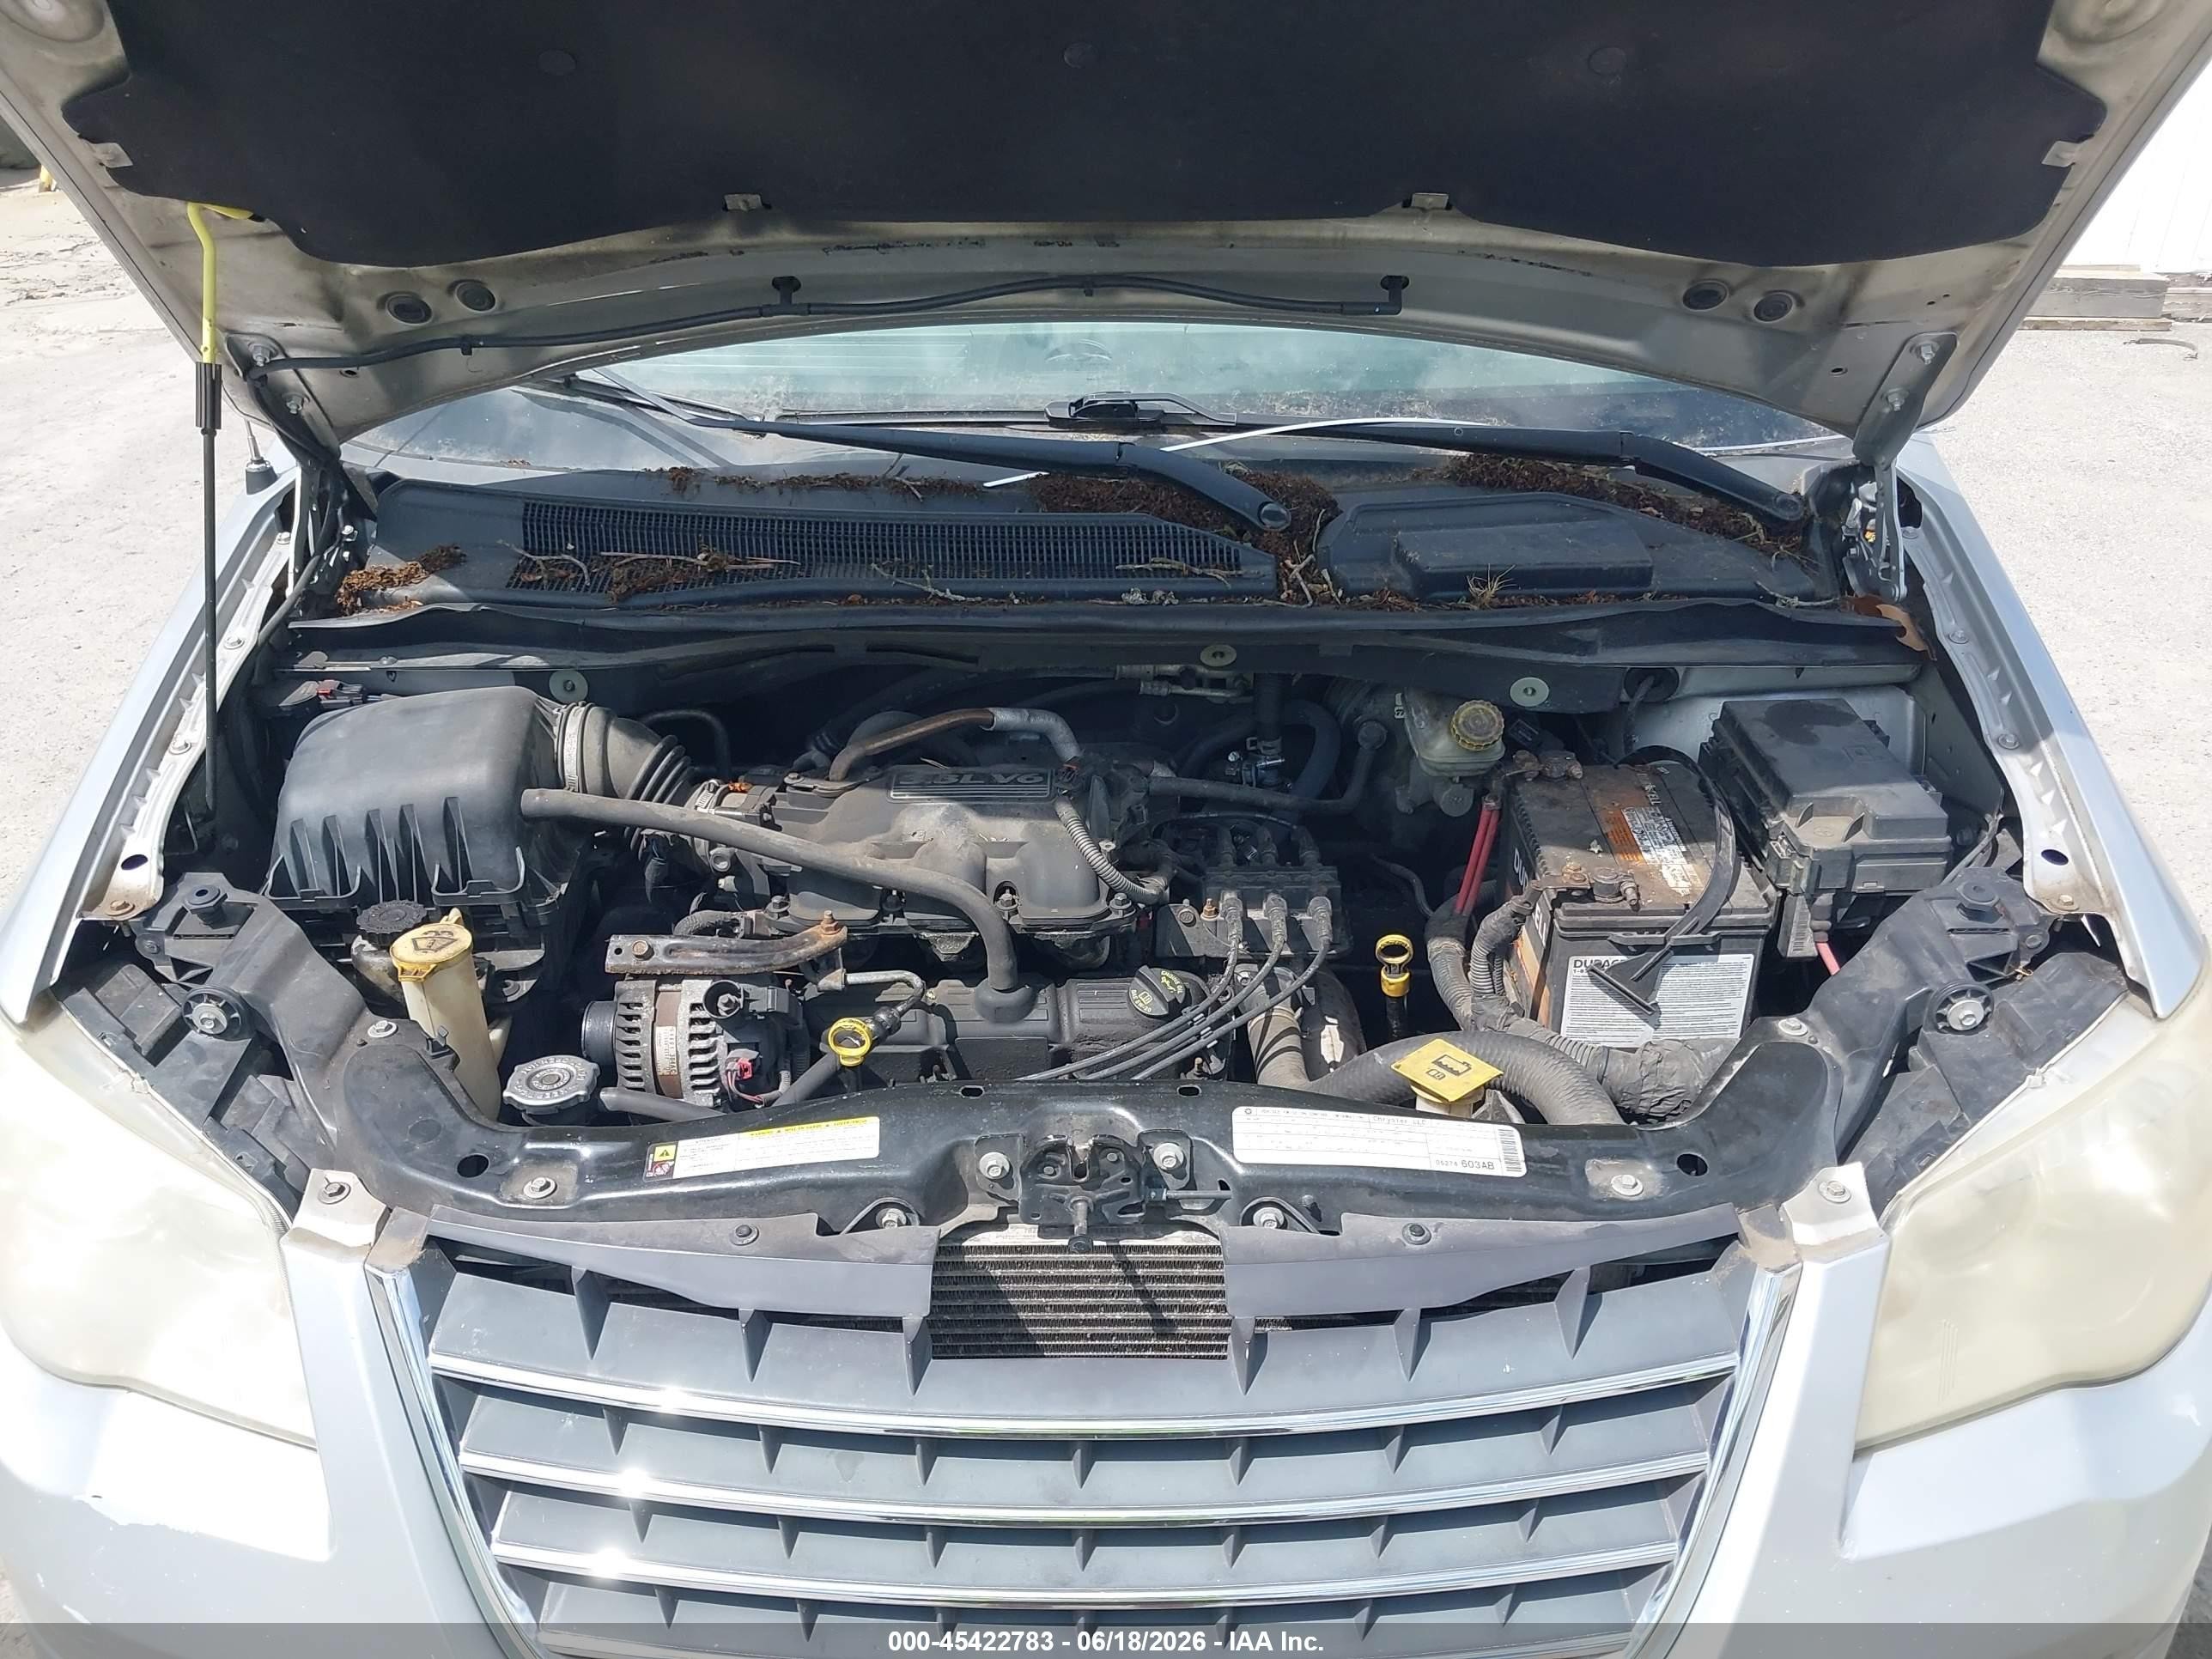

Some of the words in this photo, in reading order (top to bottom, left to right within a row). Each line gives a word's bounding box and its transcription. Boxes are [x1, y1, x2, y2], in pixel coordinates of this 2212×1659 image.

[990, 774, 1044, 784] V6
[1161, 970, 1181, 985] ENGINE
[1134, 1000, 1152, 1012] 5W-20
[1373, 1115, 1408, 1125] Chrysler
[1461, 1158, 1495, 1170] 603AB
